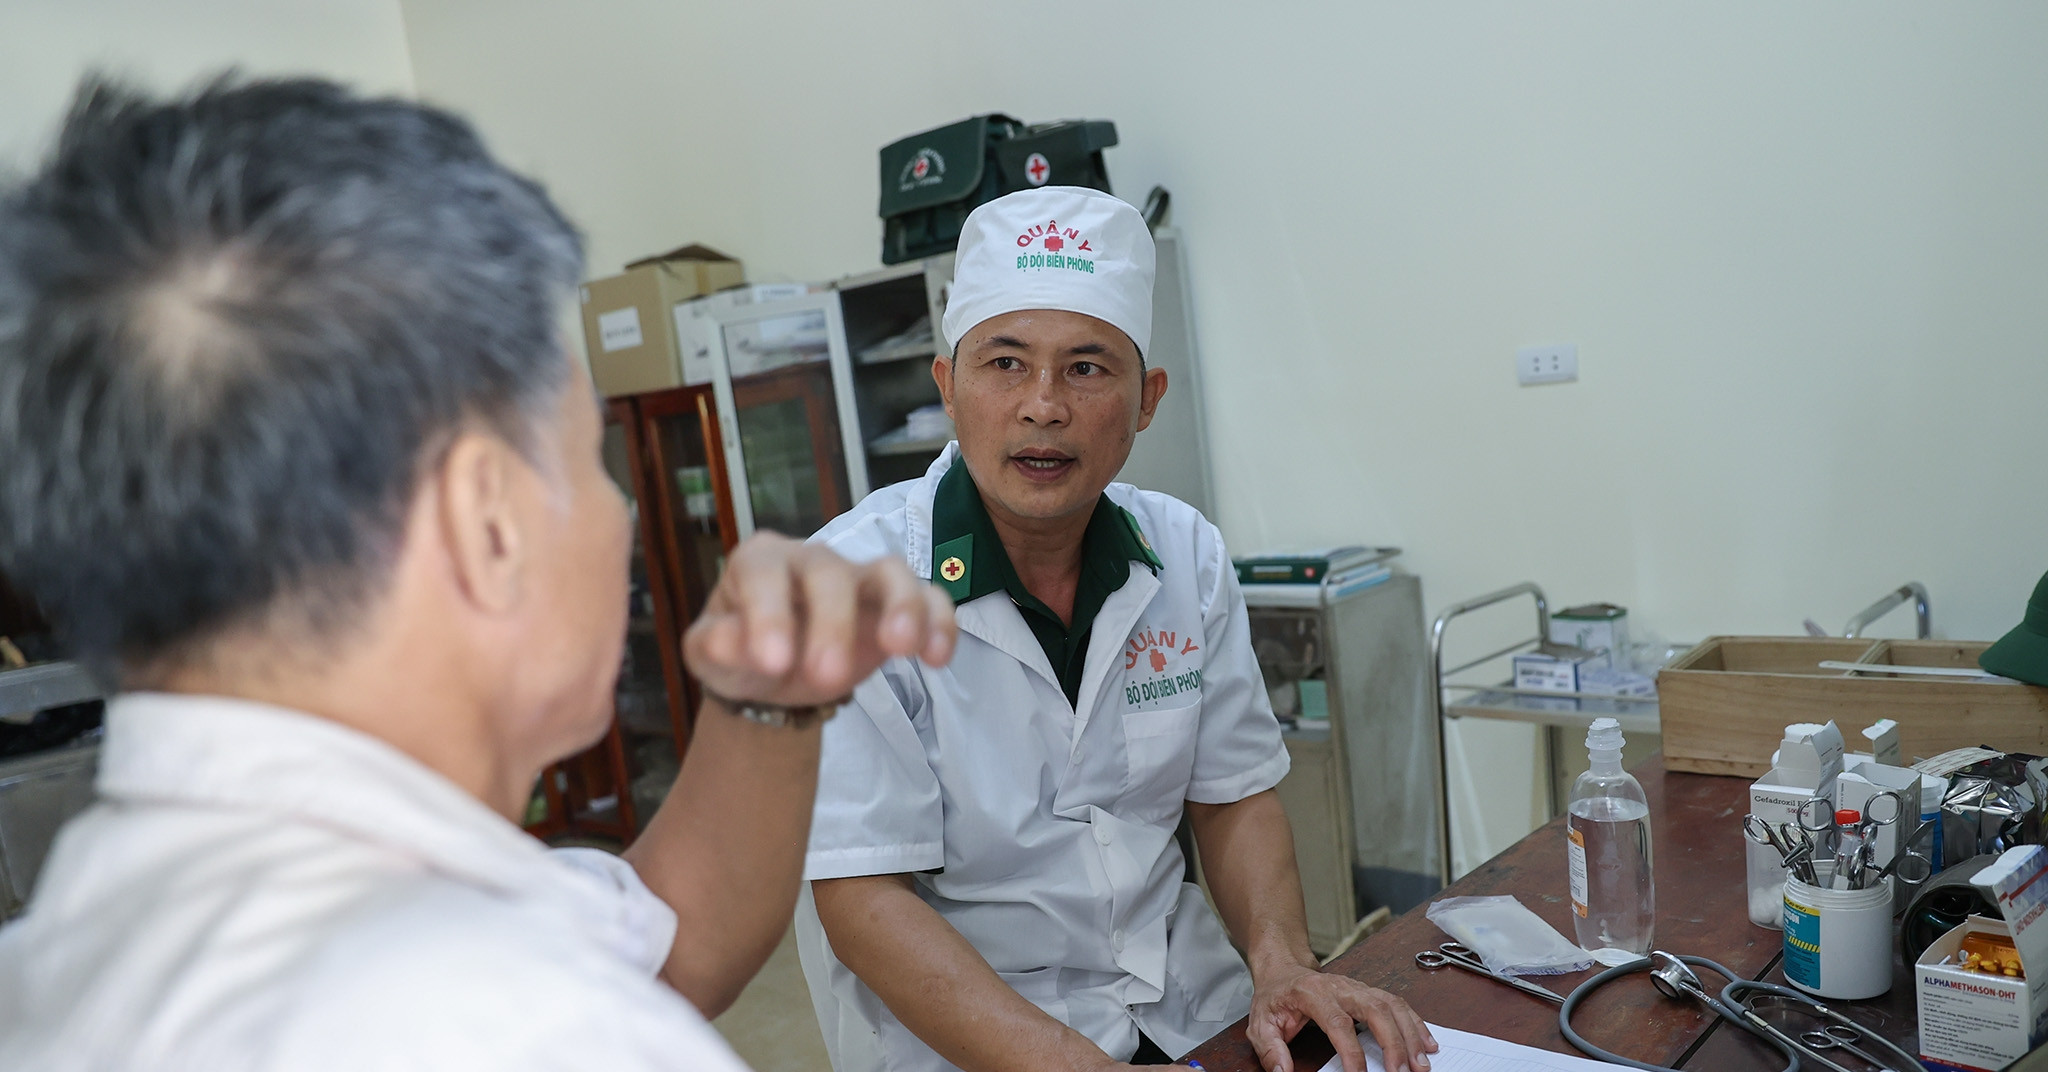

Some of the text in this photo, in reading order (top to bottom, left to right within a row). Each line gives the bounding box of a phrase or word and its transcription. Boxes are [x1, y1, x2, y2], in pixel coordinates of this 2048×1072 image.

[1016, 219, 1093, 252] QUÂN Y
[1017, 251, 1028, 273] BỘ
[1029, 251, 1045, 272] ĐỘI
[1066, 254, 1095, 274] PHÒNG
[1180, 636, 1200, 656] Y
[1125, 680, 1142, 709] BỘ
[1175, 666, 1203, 694] PHÒN
[1754, 795, 1796, 807] Cefadroxil
[1924, 976, 2017, 1000] ALPHAMETHASON-DHT
